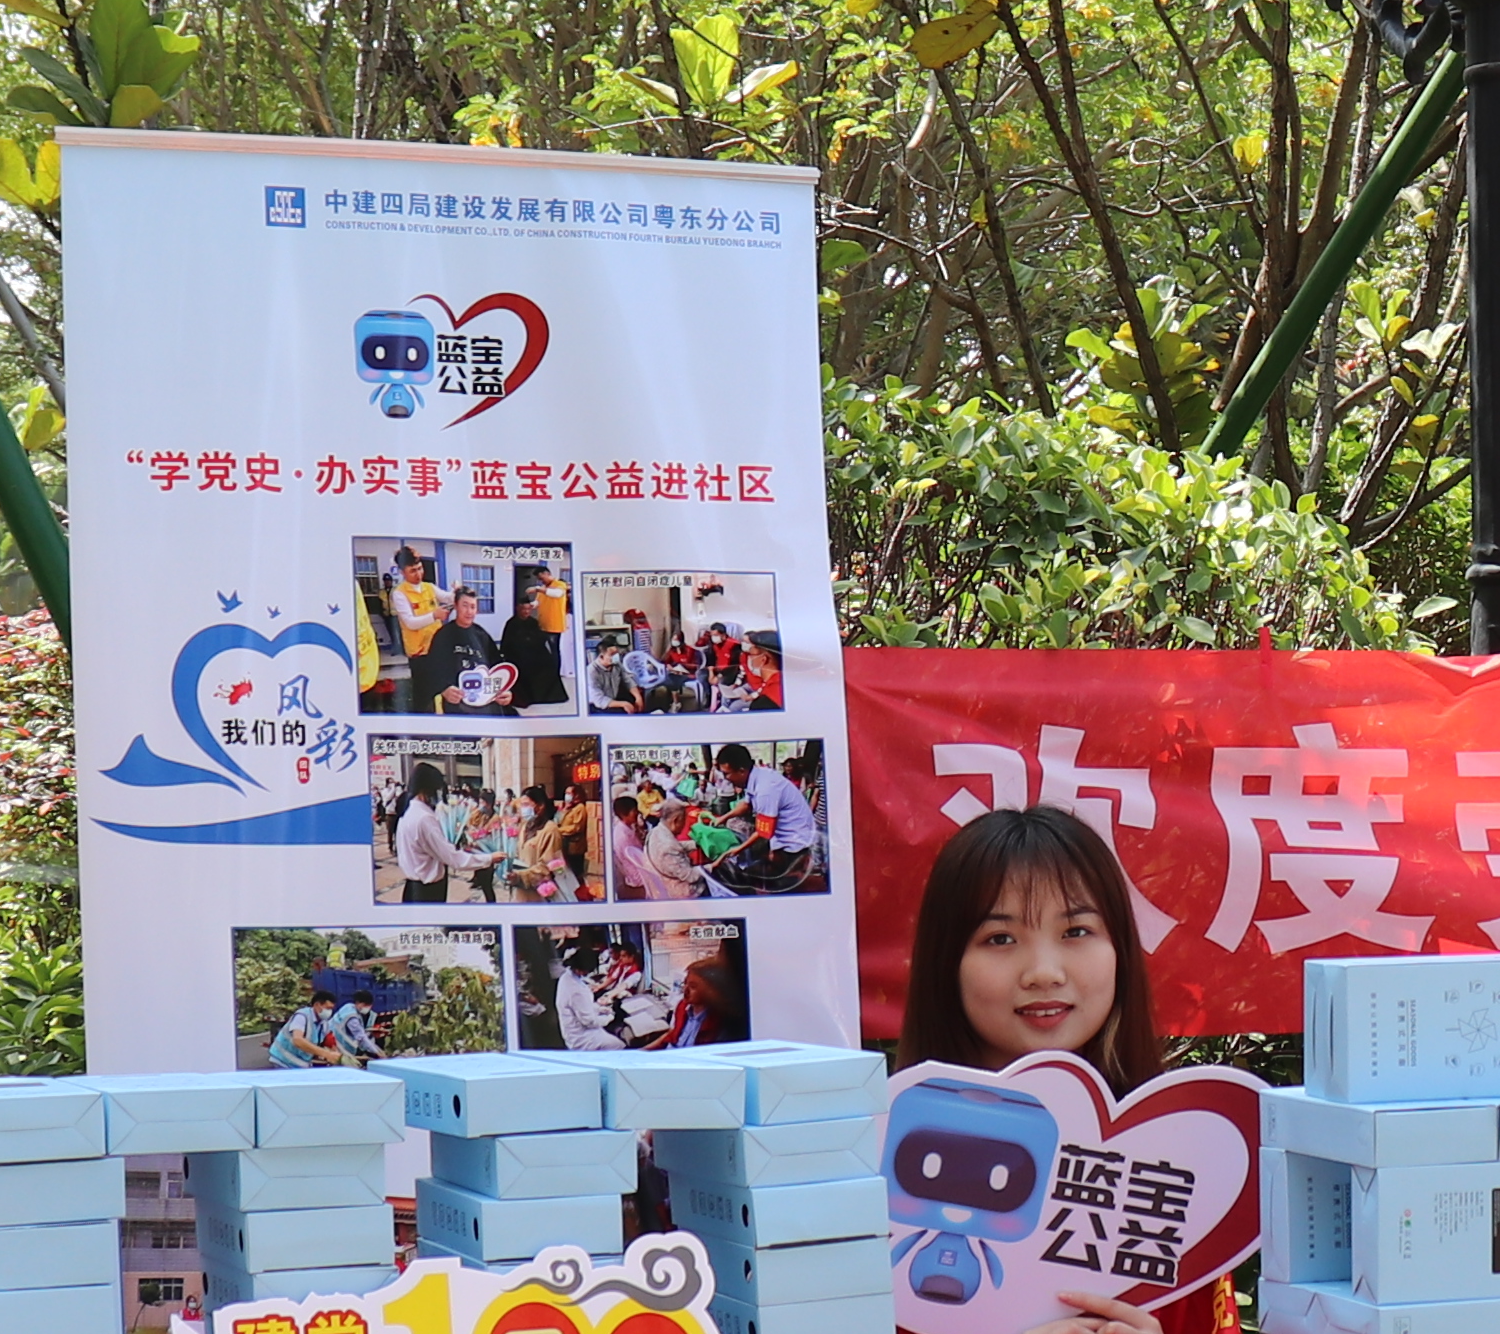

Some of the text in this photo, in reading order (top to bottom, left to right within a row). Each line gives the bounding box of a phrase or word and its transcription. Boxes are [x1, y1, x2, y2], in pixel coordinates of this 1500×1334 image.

[324, 188, 783, 235] 中建四局建设发展有限公司粤东分公司
[325, 220, 398, 233] CONSTRUCTION
[407, 223, 473, 236] DEVELOPMENT
[513, 228, 526, 238] OF
[526, 228, 556, 239] CHINA
[556, 228, 628, 242] CONSTRUCTION
[628, 231, 664, 244] FOURTH
[664, 233, 701, 245] BUREAU
[701, 235, 746, 248] YUEDONG
[436, 333, 504, 365] 蓝宝
[437, 365, 504, 396] 公益
[482, 547, 563, 561] 为工人义务理发
[588, 574, 693, 588] 关怀慰问自闭症儿童
[221, 718, 306, 747] 我们的
[613, 748, 694, 761] 重阳节慰问老人
[1050, 1143, 1196, 1224] 蓝宝
[1038, 1206, 1185, 1288] 公益
